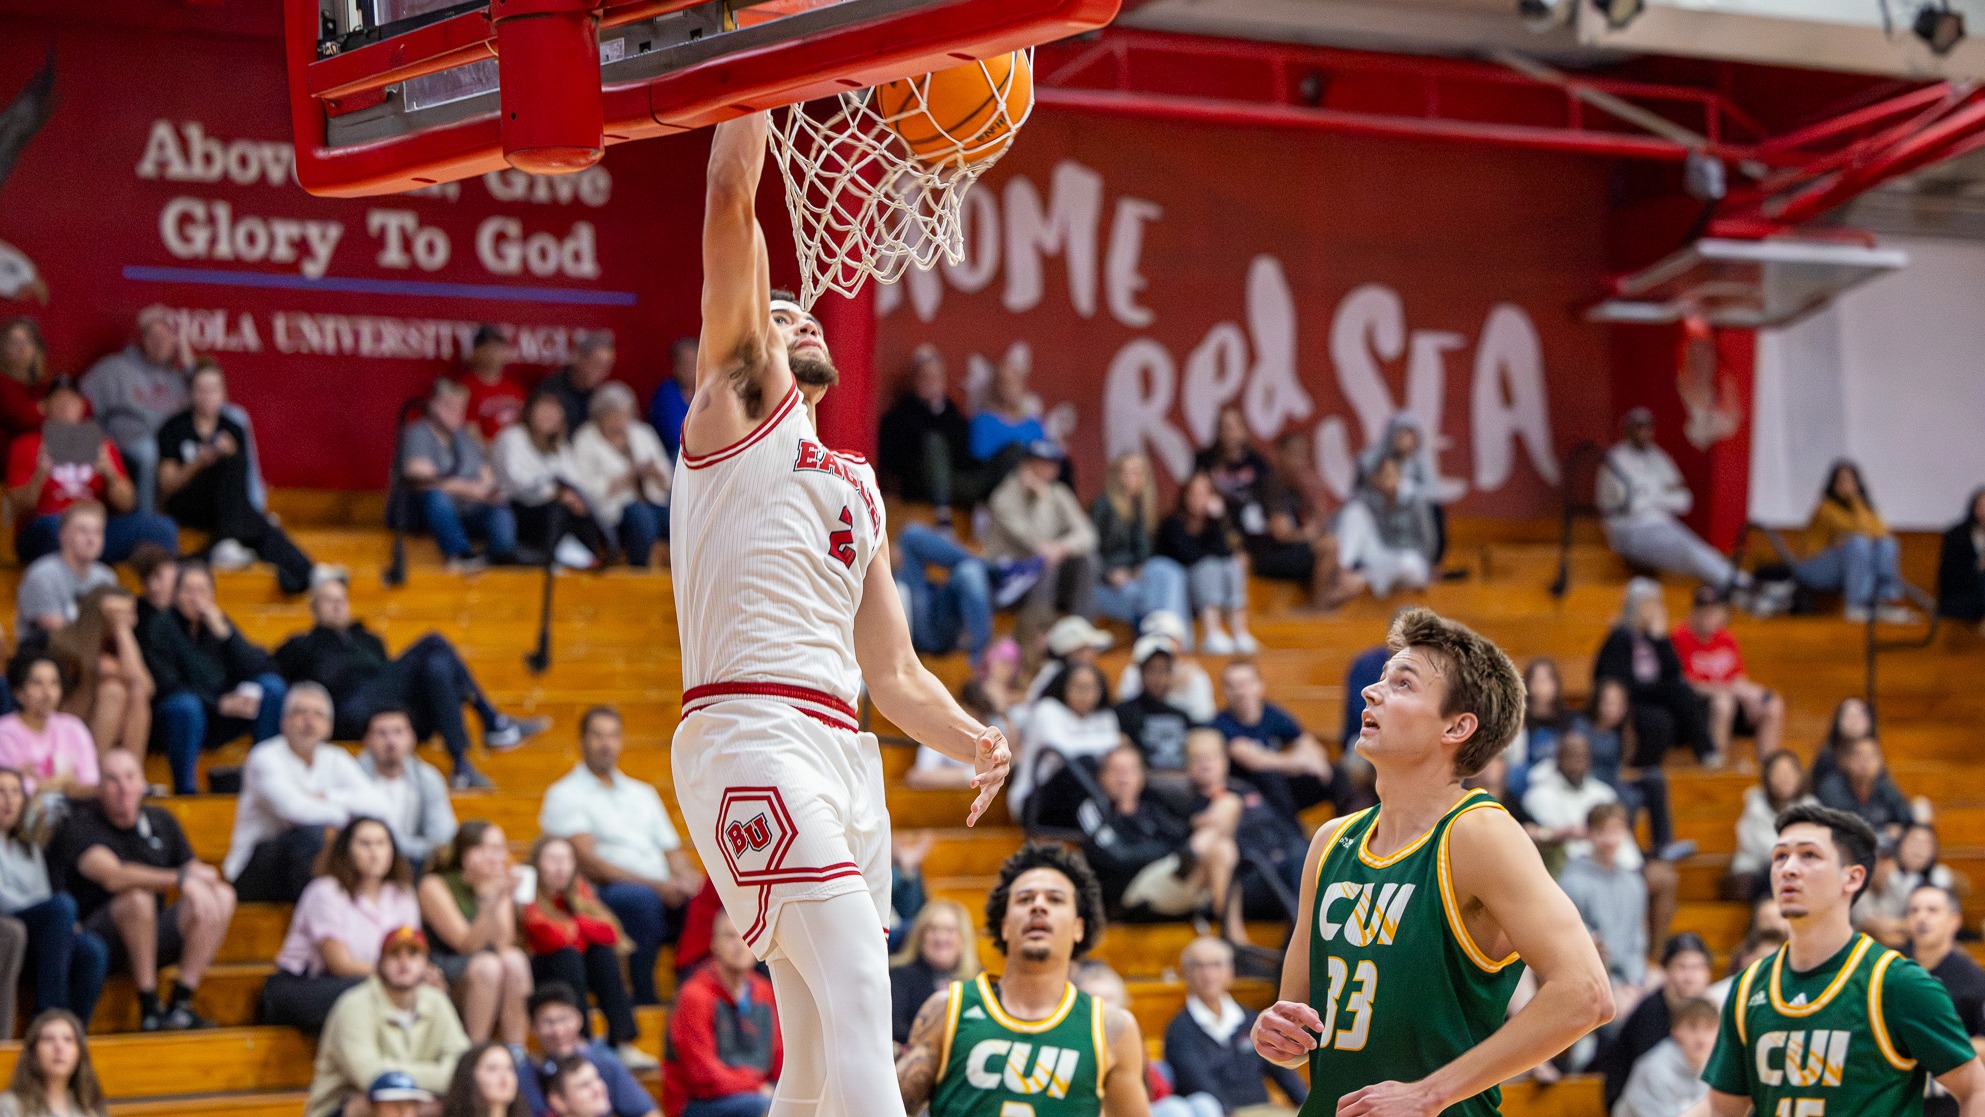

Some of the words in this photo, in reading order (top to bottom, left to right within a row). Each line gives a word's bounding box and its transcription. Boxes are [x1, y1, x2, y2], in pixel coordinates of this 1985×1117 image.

[135, 118, 298, 187] Abov
[159, 197, 345, 279] Glory
[366, 208, 451, 272] To
[475, 215, 601, 280] God
[167, 307, 263, 353] IOLA
[828, 505, 856, 570] 2
[725, 812, 773, 860] BU
[1319, 881, 1416, 947] CUI
[1319, 955, 1378, 1051] 33
[966, 1038, 1080, 1100] CUI
[1756, 1029, 1852, 1087] CUI
